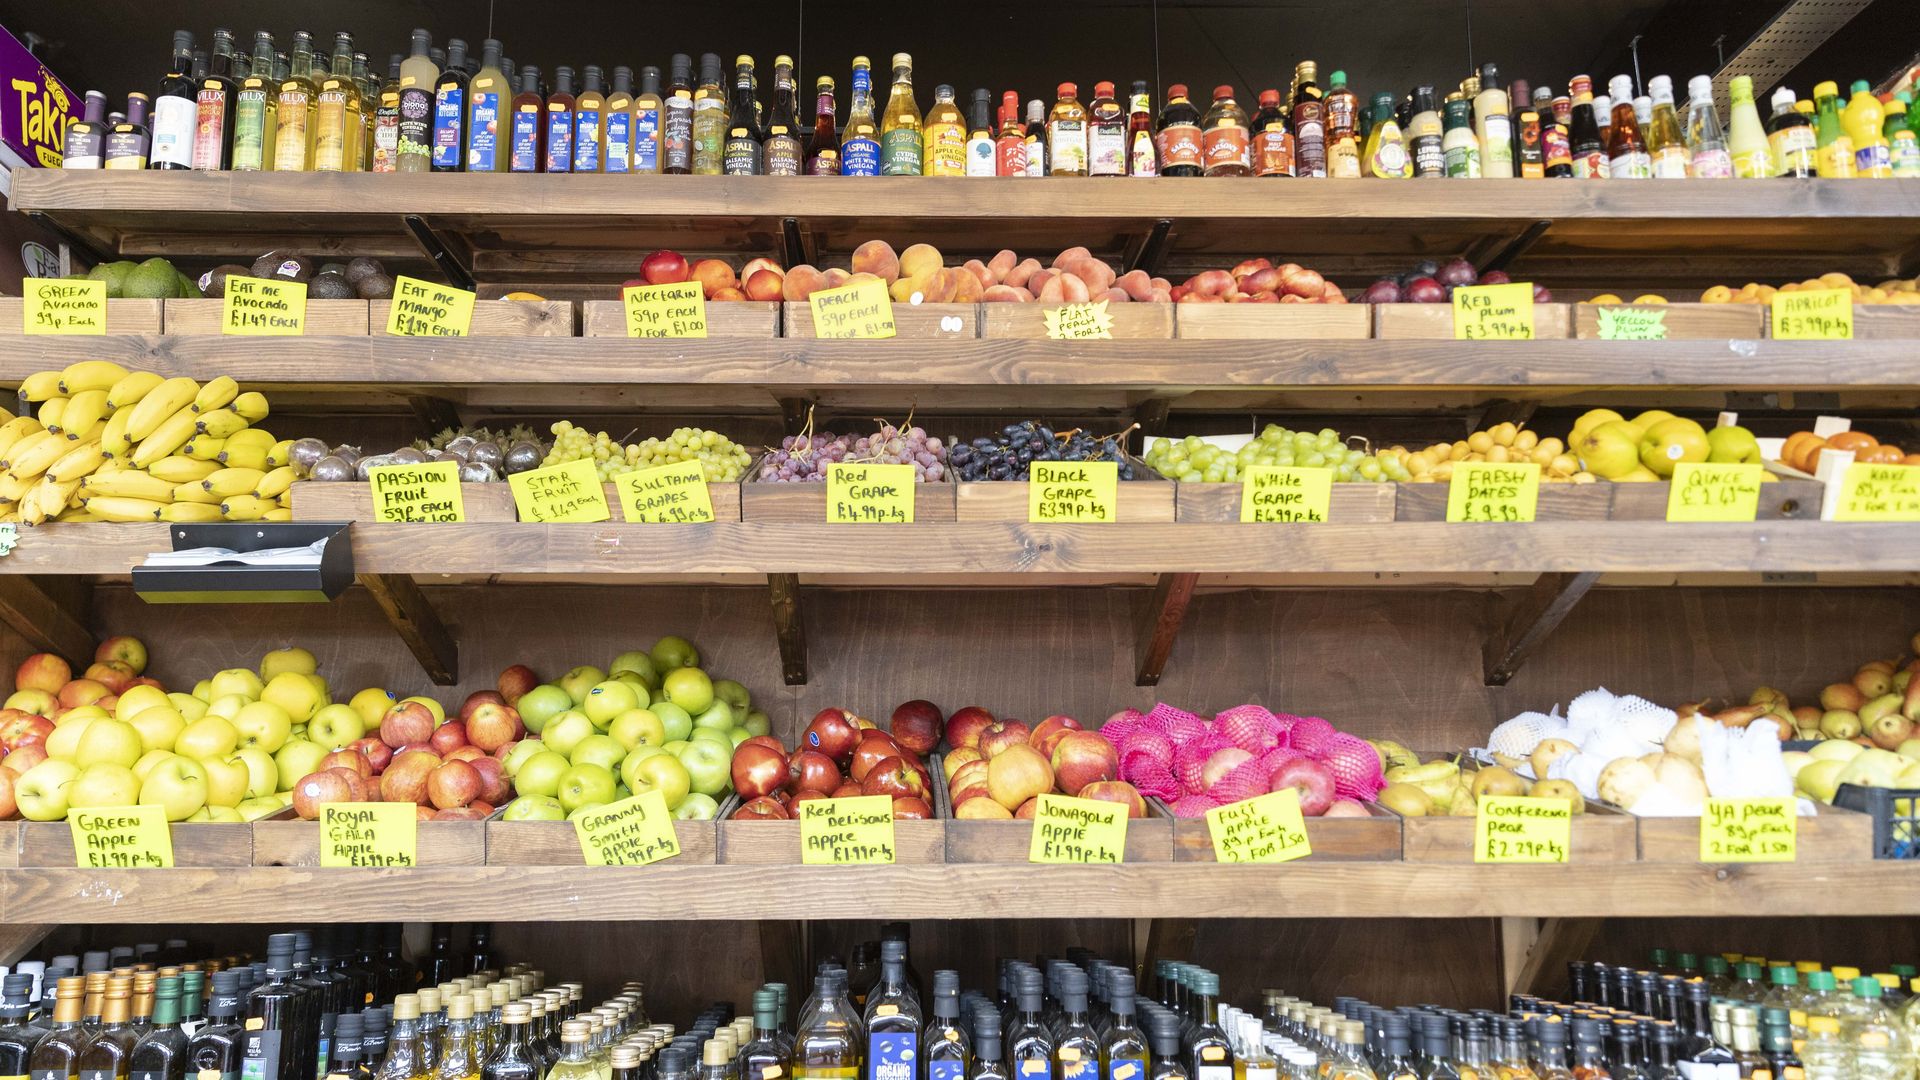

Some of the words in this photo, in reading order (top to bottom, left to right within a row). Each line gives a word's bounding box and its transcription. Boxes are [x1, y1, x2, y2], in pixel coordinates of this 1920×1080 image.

[198, 92, 223, 101] VILUX
[239, 93, 264, 101] VILUX
[280, 93, 306, 103] VILUX
[319, 93, 344, 103] VILUX
[12, 79, 80, 152] Taki
[725, 142, 753, 154] ASPALL
[845, 143, 874, 156] ASPALL
[43, 153, 62, 166] FUEG
[892, 157, 920, 165] VINEGAR
[39, 285, 90, 299] GREEN
[231, 280, 256, 293] EAT
[402, 282, 428, 298] EAT
[1461, 294, 1491, 310] RED
[231, 310, 266, 326] £1.49
[270, 316, 297, 328] EACH
[633, 309, 659, 324] 59p
[667, 306, 696, 318] EACH
[822, 312, 846, 326] 59p
[849, 304, 878, 320] EACH
[1060, 308, 1091, 322] FLAT
[433, 325, 460, 336] EACH
[646, 329, 668, 337] FOR
[673, 321, 703, 335] £1.00
[1059, 316, 1095, 331] PEACH
[1465, 323, 1507, 340] £3.99
[1781, 317, 1822, 334] £3.99
[1074, 328, 1092, 337] FOR
[377, 472, 446, 492] PASSION
[526, 472, 571, 489] STAR
[835, 468, 867, 484] Red
[1469, 470, 1526, 488] FRESH
[1468, 486, 1518, 499] DATES
[636, 491, 688, 511] GRAPES
[384, 506, 414, 519] 59p
[421, 501, 453, 513] EACH
[838, 502, 876, 521] £4.99
[1039, 502, 1073, 517] £3.99
[1256, 509, 1291, 522] £4.99
[806, 804, 835, 819] Red
[78, 814, 140, 831] GREEN
[1227, 816, 1270, 835] APPLE
[834, 845, 867, 861] £1.99
[1044, 841, 1081, 860] £1.99
[1251, 843, 1275, 859] FOR
[1488, 839, 1532, 858] £2.29
[1711, 842, 1722, 853] 2
[1727, 844, 1752, 854] FOR
[89, 852, 128, 867] £1.99
[876, 1065, 910, 1076] ORGANIC
